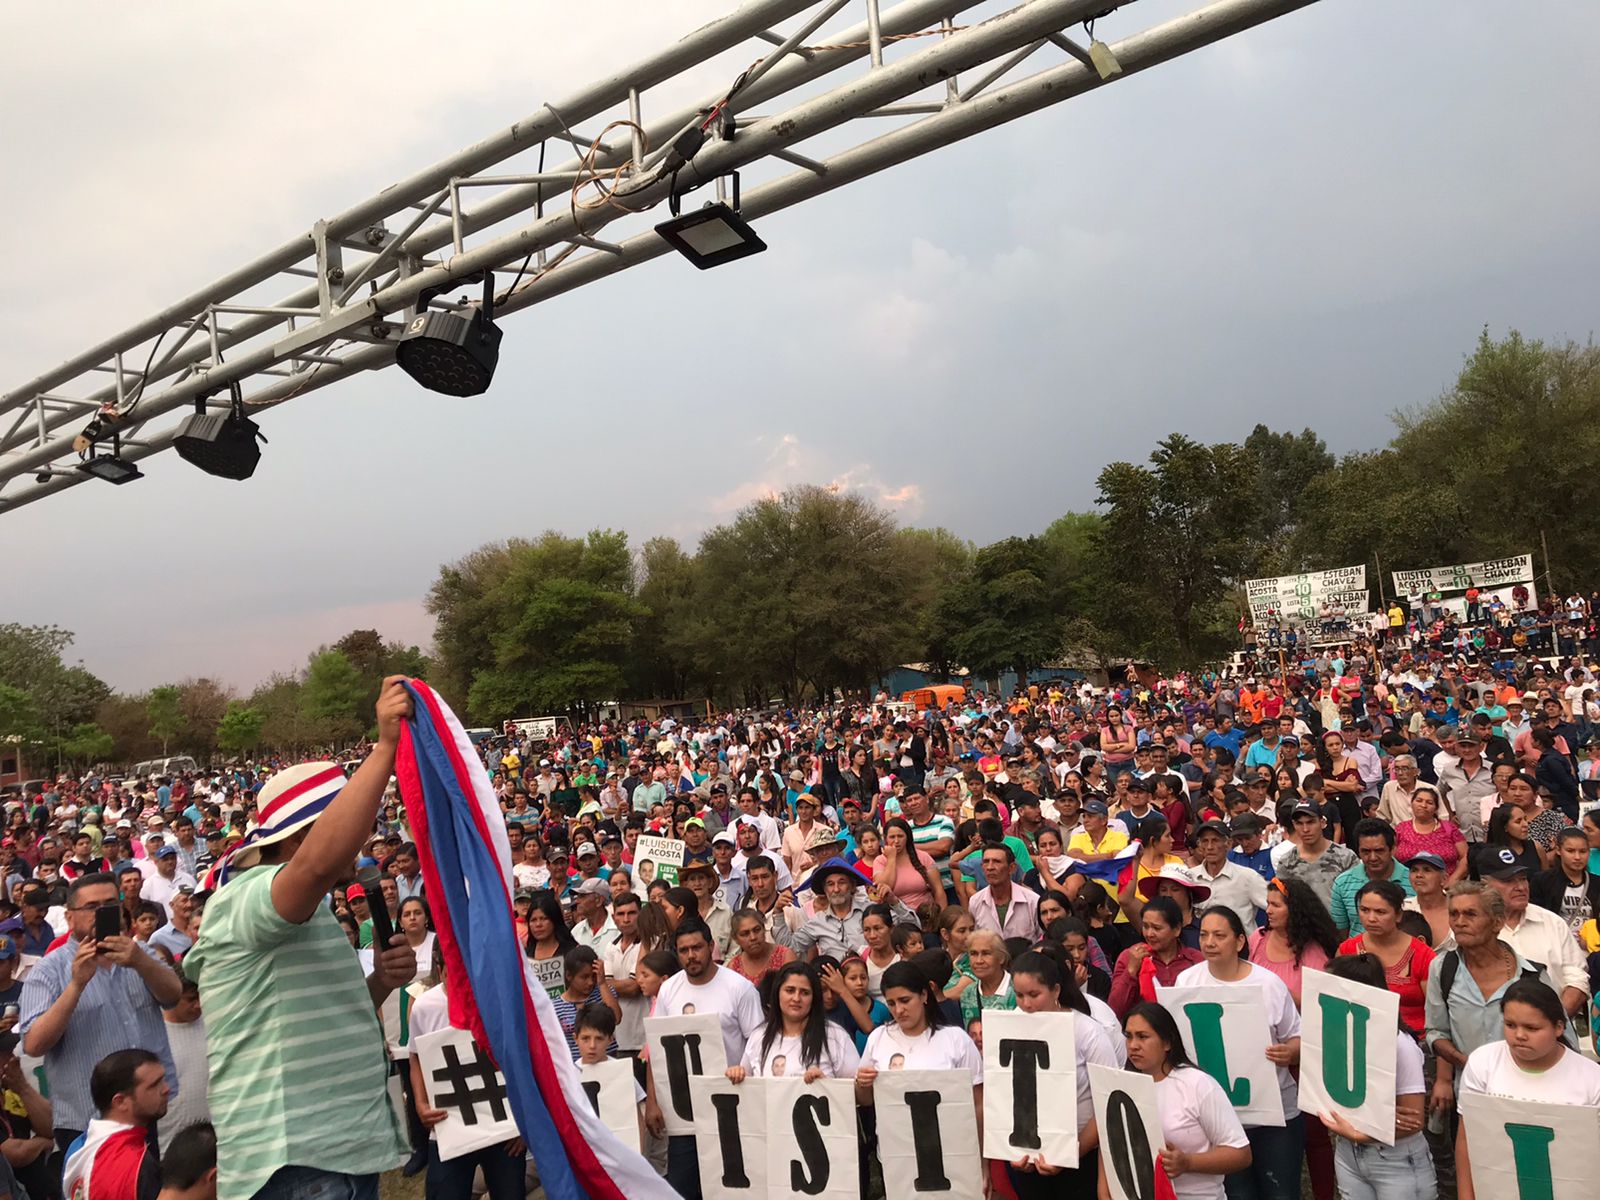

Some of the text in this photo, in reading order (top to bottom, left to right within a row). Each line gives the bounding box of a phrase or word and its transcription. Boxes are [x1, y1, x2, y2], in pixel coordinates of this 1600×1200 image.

[1248, 578, 1279, 590] LUISITO
[1323, 567, 1362, 579] ESTEBAN
[1396, 569, 1432, 581] LUISITO
[1438, 569, 1453, 577] LISTA
[1483, 556, 1527, 571] ESTEBAN
[1398, 579, 1433, 589] ACOSTA
[1484, 568, 1521, 579] CHAVEZ
[1249, 586, 1278, 597] ACOSTA
[1297, 583, 1311, 596] 10
[1322, 577, 1356, 587] CHAVEZ
[1320, 585, 1356, 594] CONCEJAL
[1253, 600, 1282, 612] LUISITO
[1327, 592, 1366, 603] ESTEBAN
[639, 838, 683, 851] #LUISITO
[648, 848, 681, 859] ACOSTA
[1183, 1002, 1250, 1106] L
[1318, 993, 1370, 1109] U
[999, 1038, 1051, 1150] T
[711, 1093, 751, 1189] I
[790, 1094, 831, 1196] S
[904, 1090, 951, 1192] I
[1106, 1089, 1156, 1200] O
